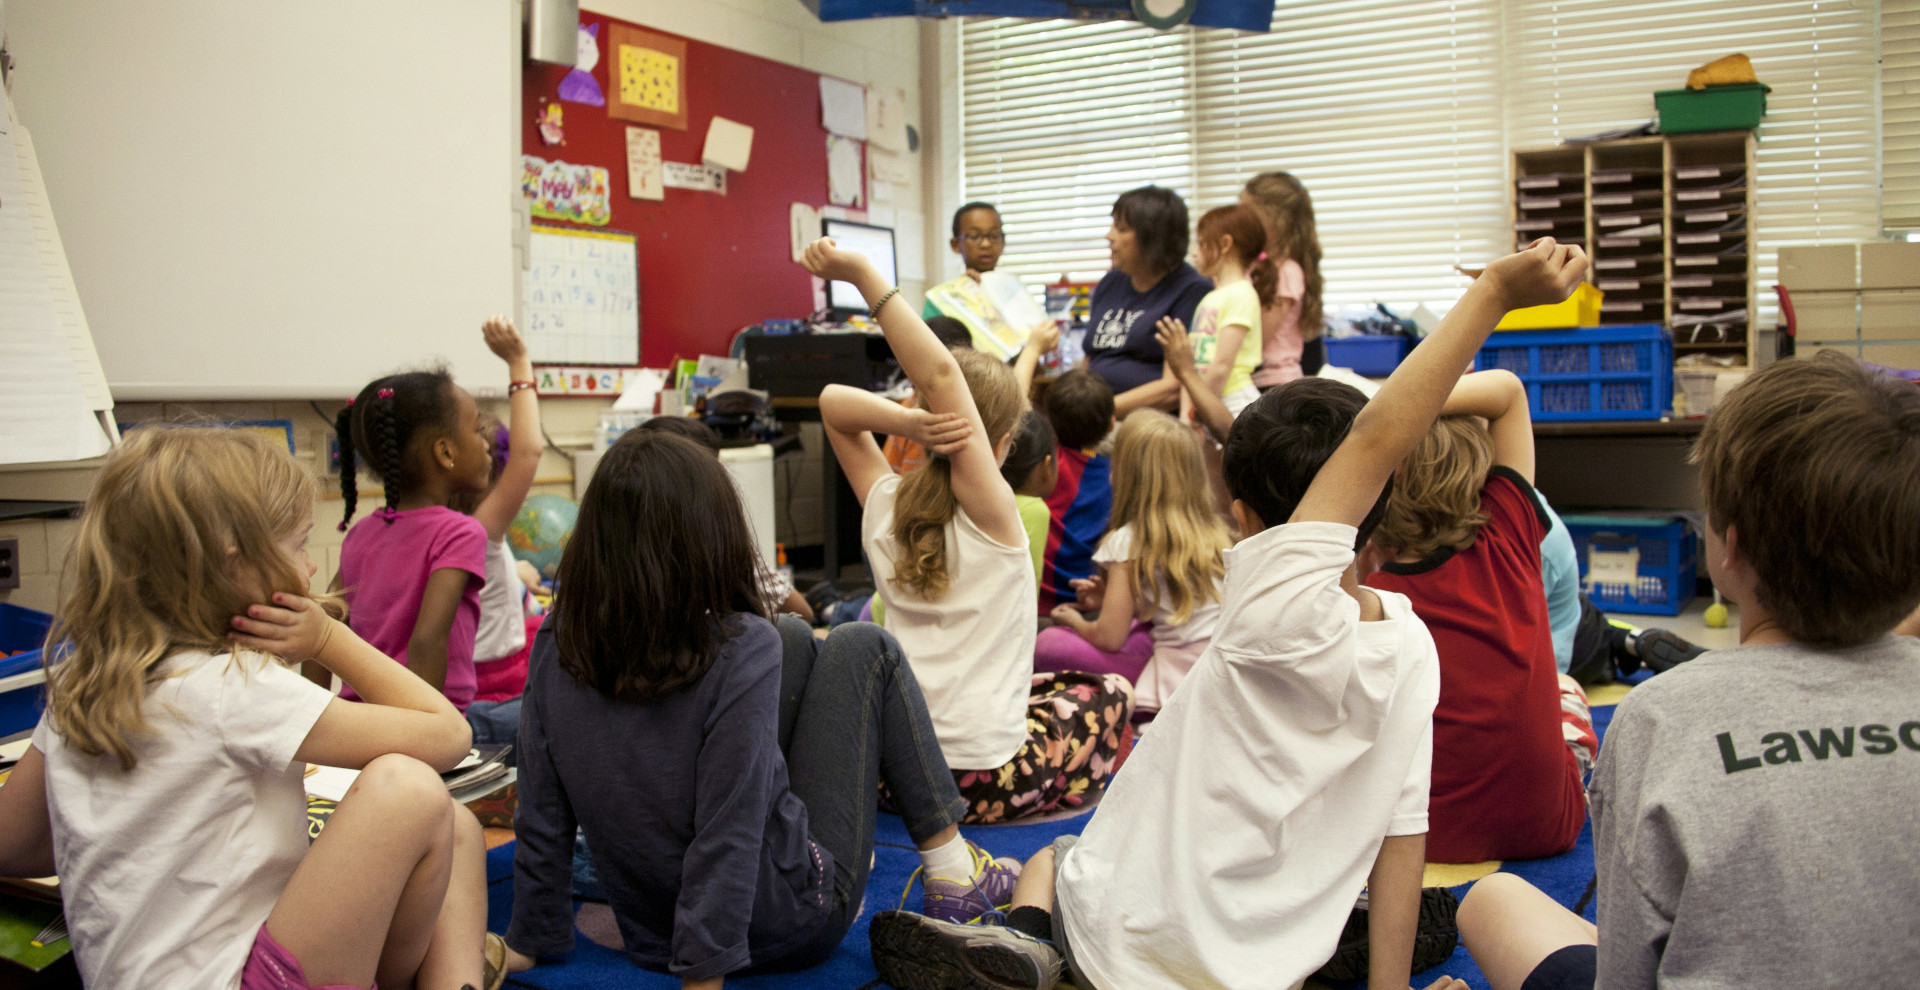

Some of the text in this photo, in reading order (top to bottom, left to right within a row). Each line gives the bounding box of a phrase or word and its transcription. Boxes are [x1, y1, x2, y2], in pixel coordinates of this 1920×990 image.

[541, 373, 612, 389] A B C
